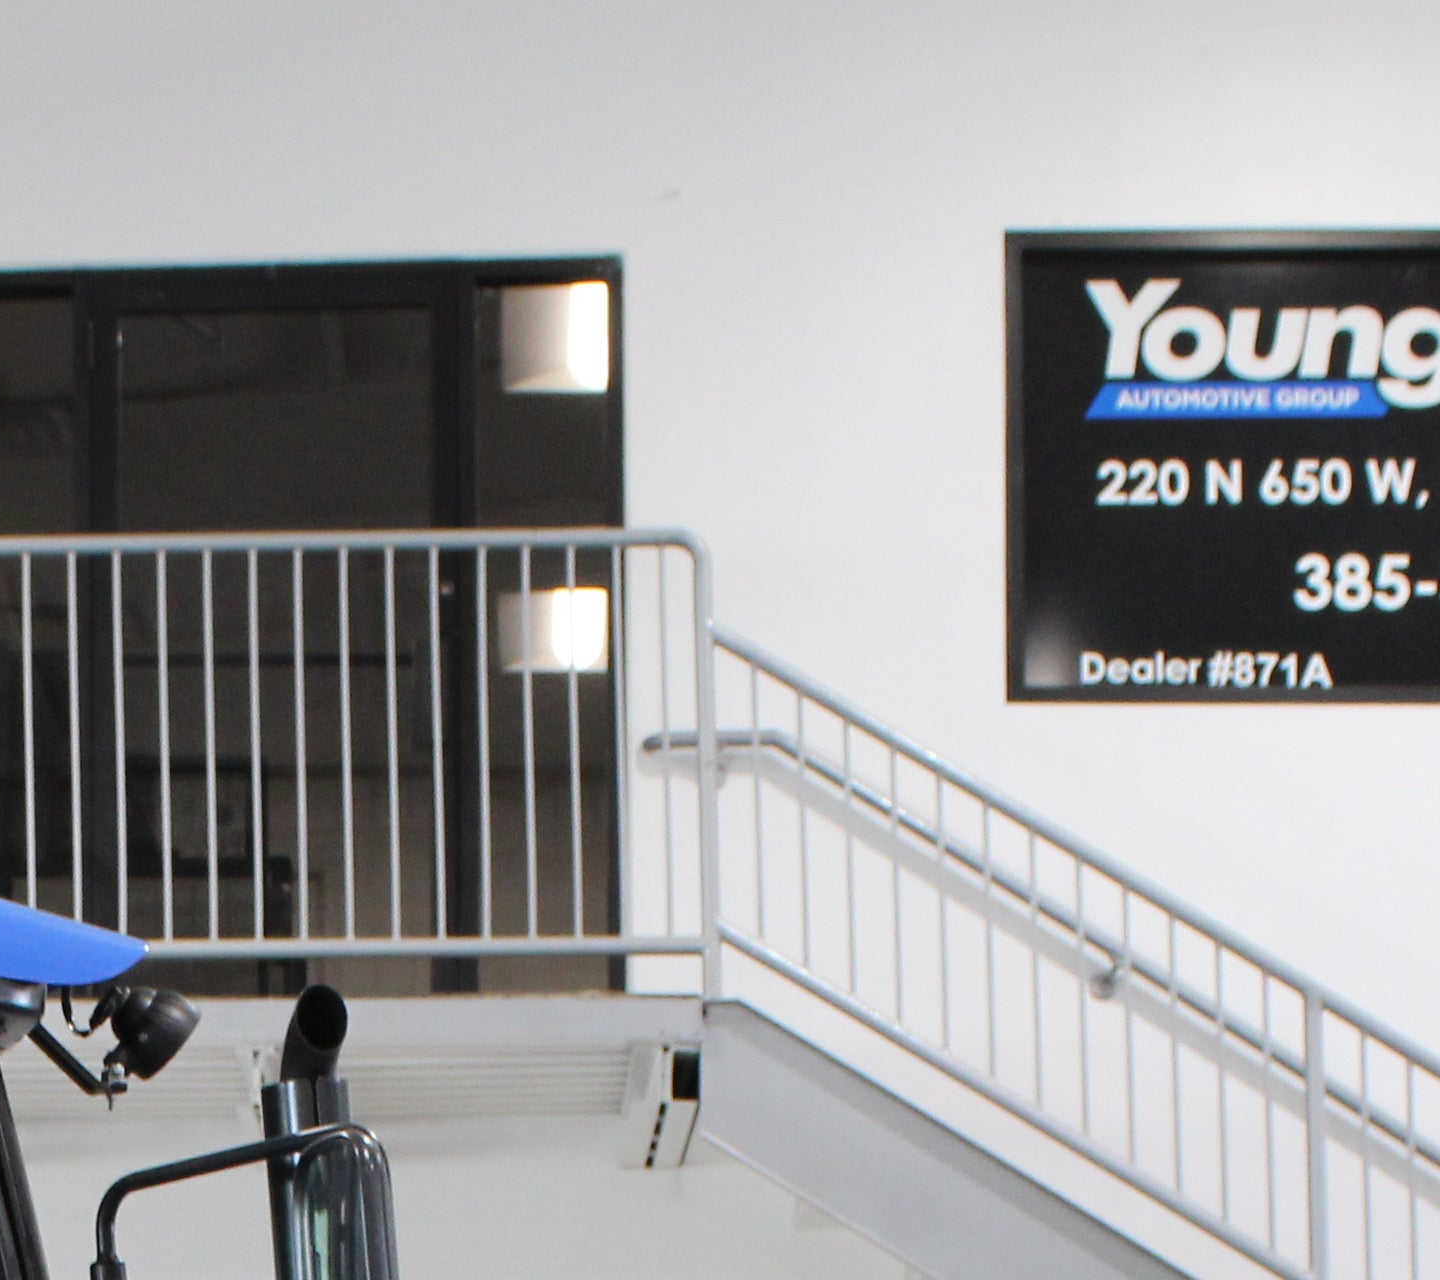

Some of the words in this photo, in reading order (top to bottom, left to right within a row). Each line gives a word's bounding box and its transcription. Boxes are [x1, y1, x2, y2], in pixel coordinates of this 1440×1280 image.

[1115, 387, 1271, 410] AUTOMOTIVE
[1277, 386, 1361, 410] GROUP
[1095, 456, 1190, 506] 220
[1205, 457, 1244, 506] N
[1259, 457, 1353, 506] 650
[1365, 456, 1430, 510] W,
[1079, 649, 1204, 686] Dealer
[1206, 649, 1335, 690] #871A
